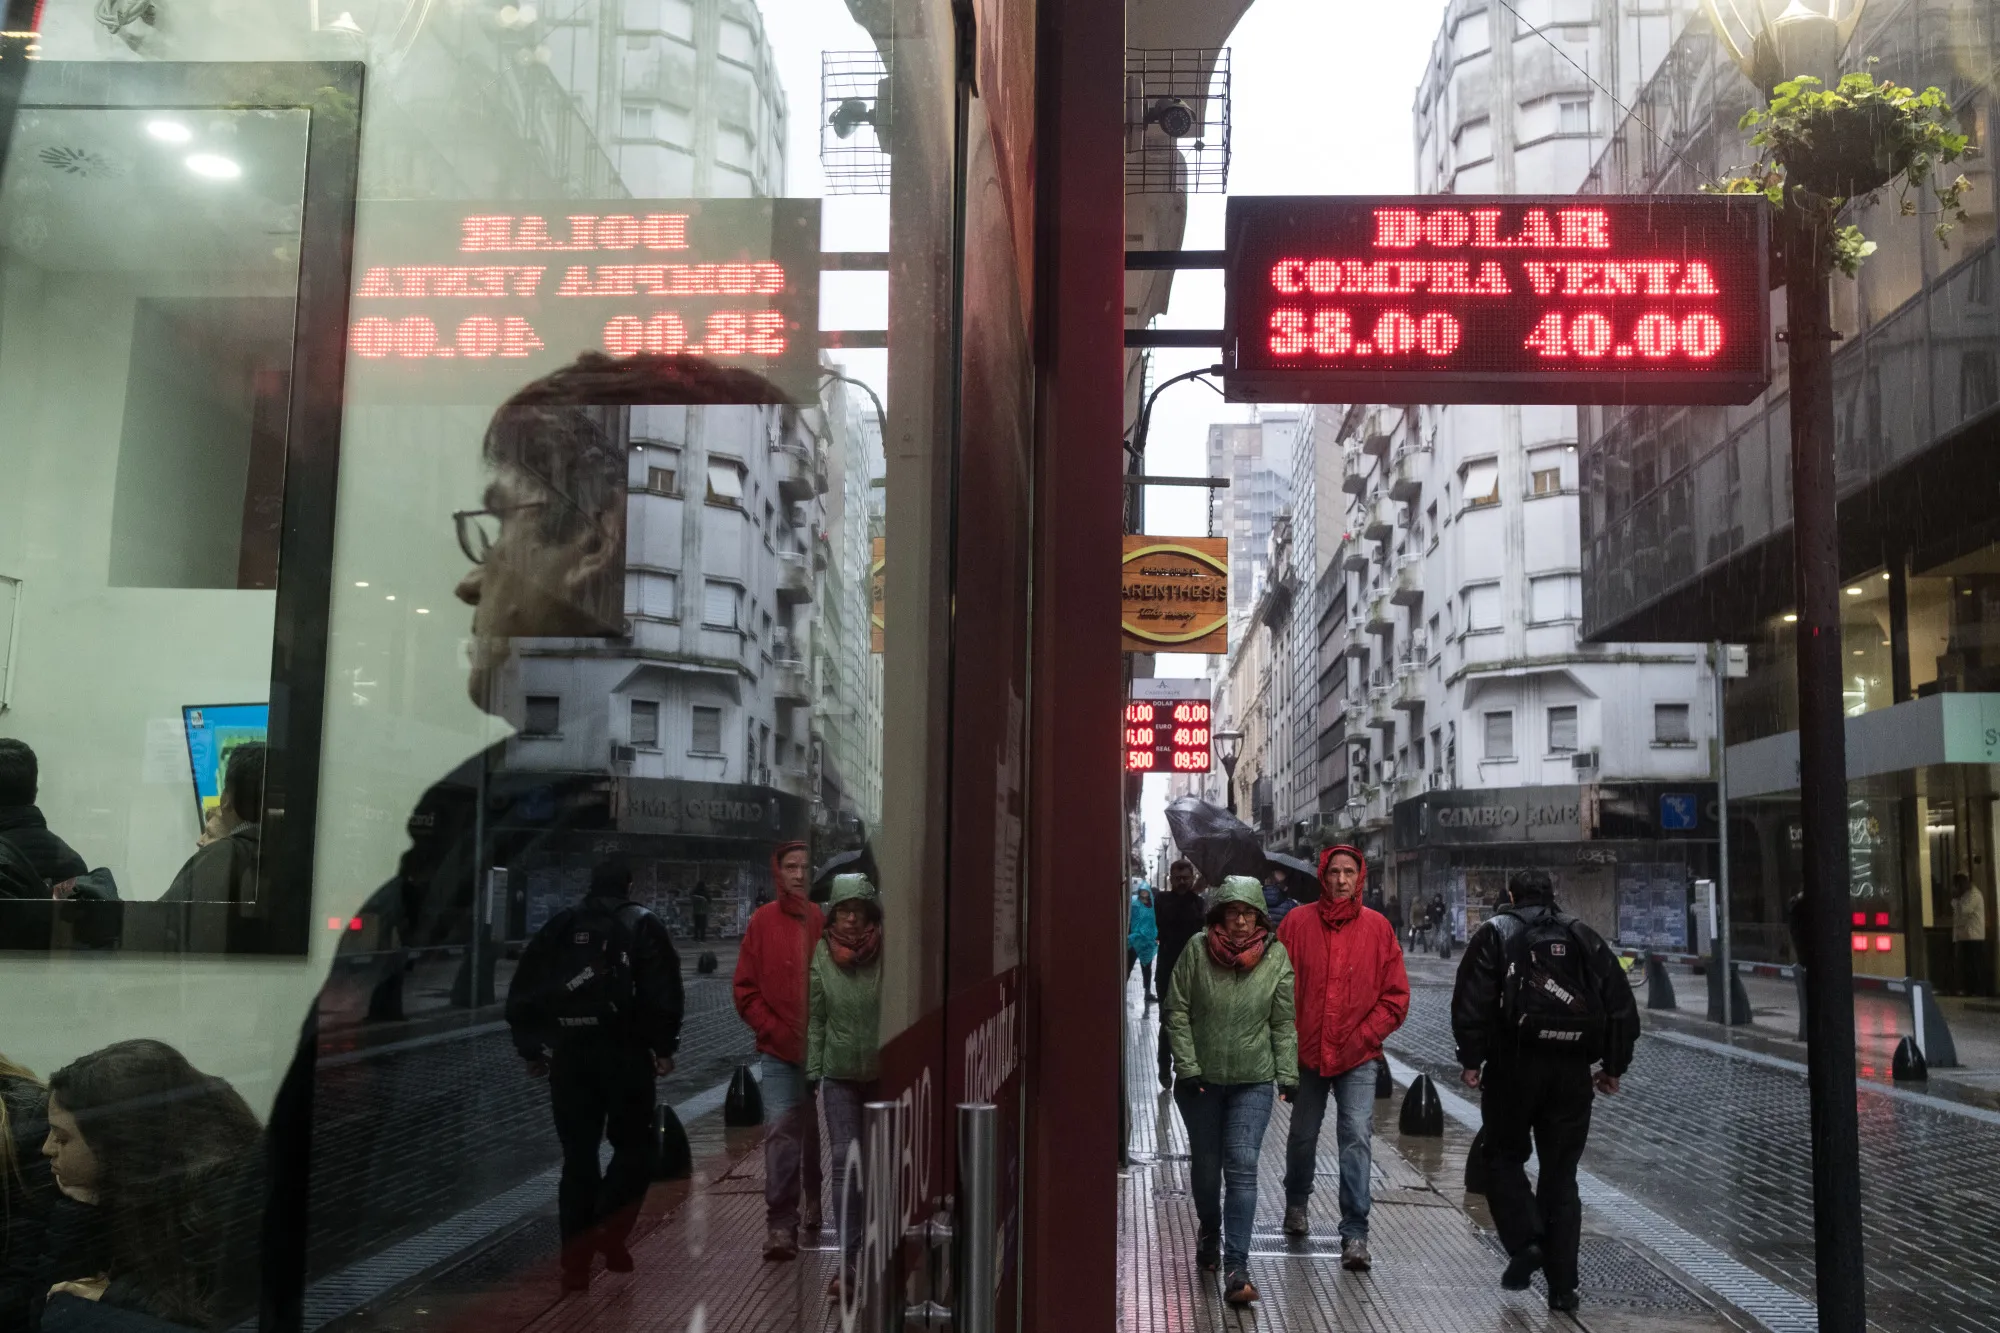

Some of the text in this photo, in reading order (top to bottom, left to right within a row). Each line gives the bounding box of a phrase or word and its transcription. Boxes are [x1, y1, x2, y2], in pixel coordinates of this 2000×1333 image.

[1372, 209, 1610, 249] DOLAR
[1270, 260, 1720, 295] COMPRA VENTA
[1269, 309, 1724, 358] 38.00 40.00
[1437, 805, 1519, 827] CAMBIO
[1544, 978, 1575, 1005] SPORT
[1539, 1030, 1583, 1041] SPORT
